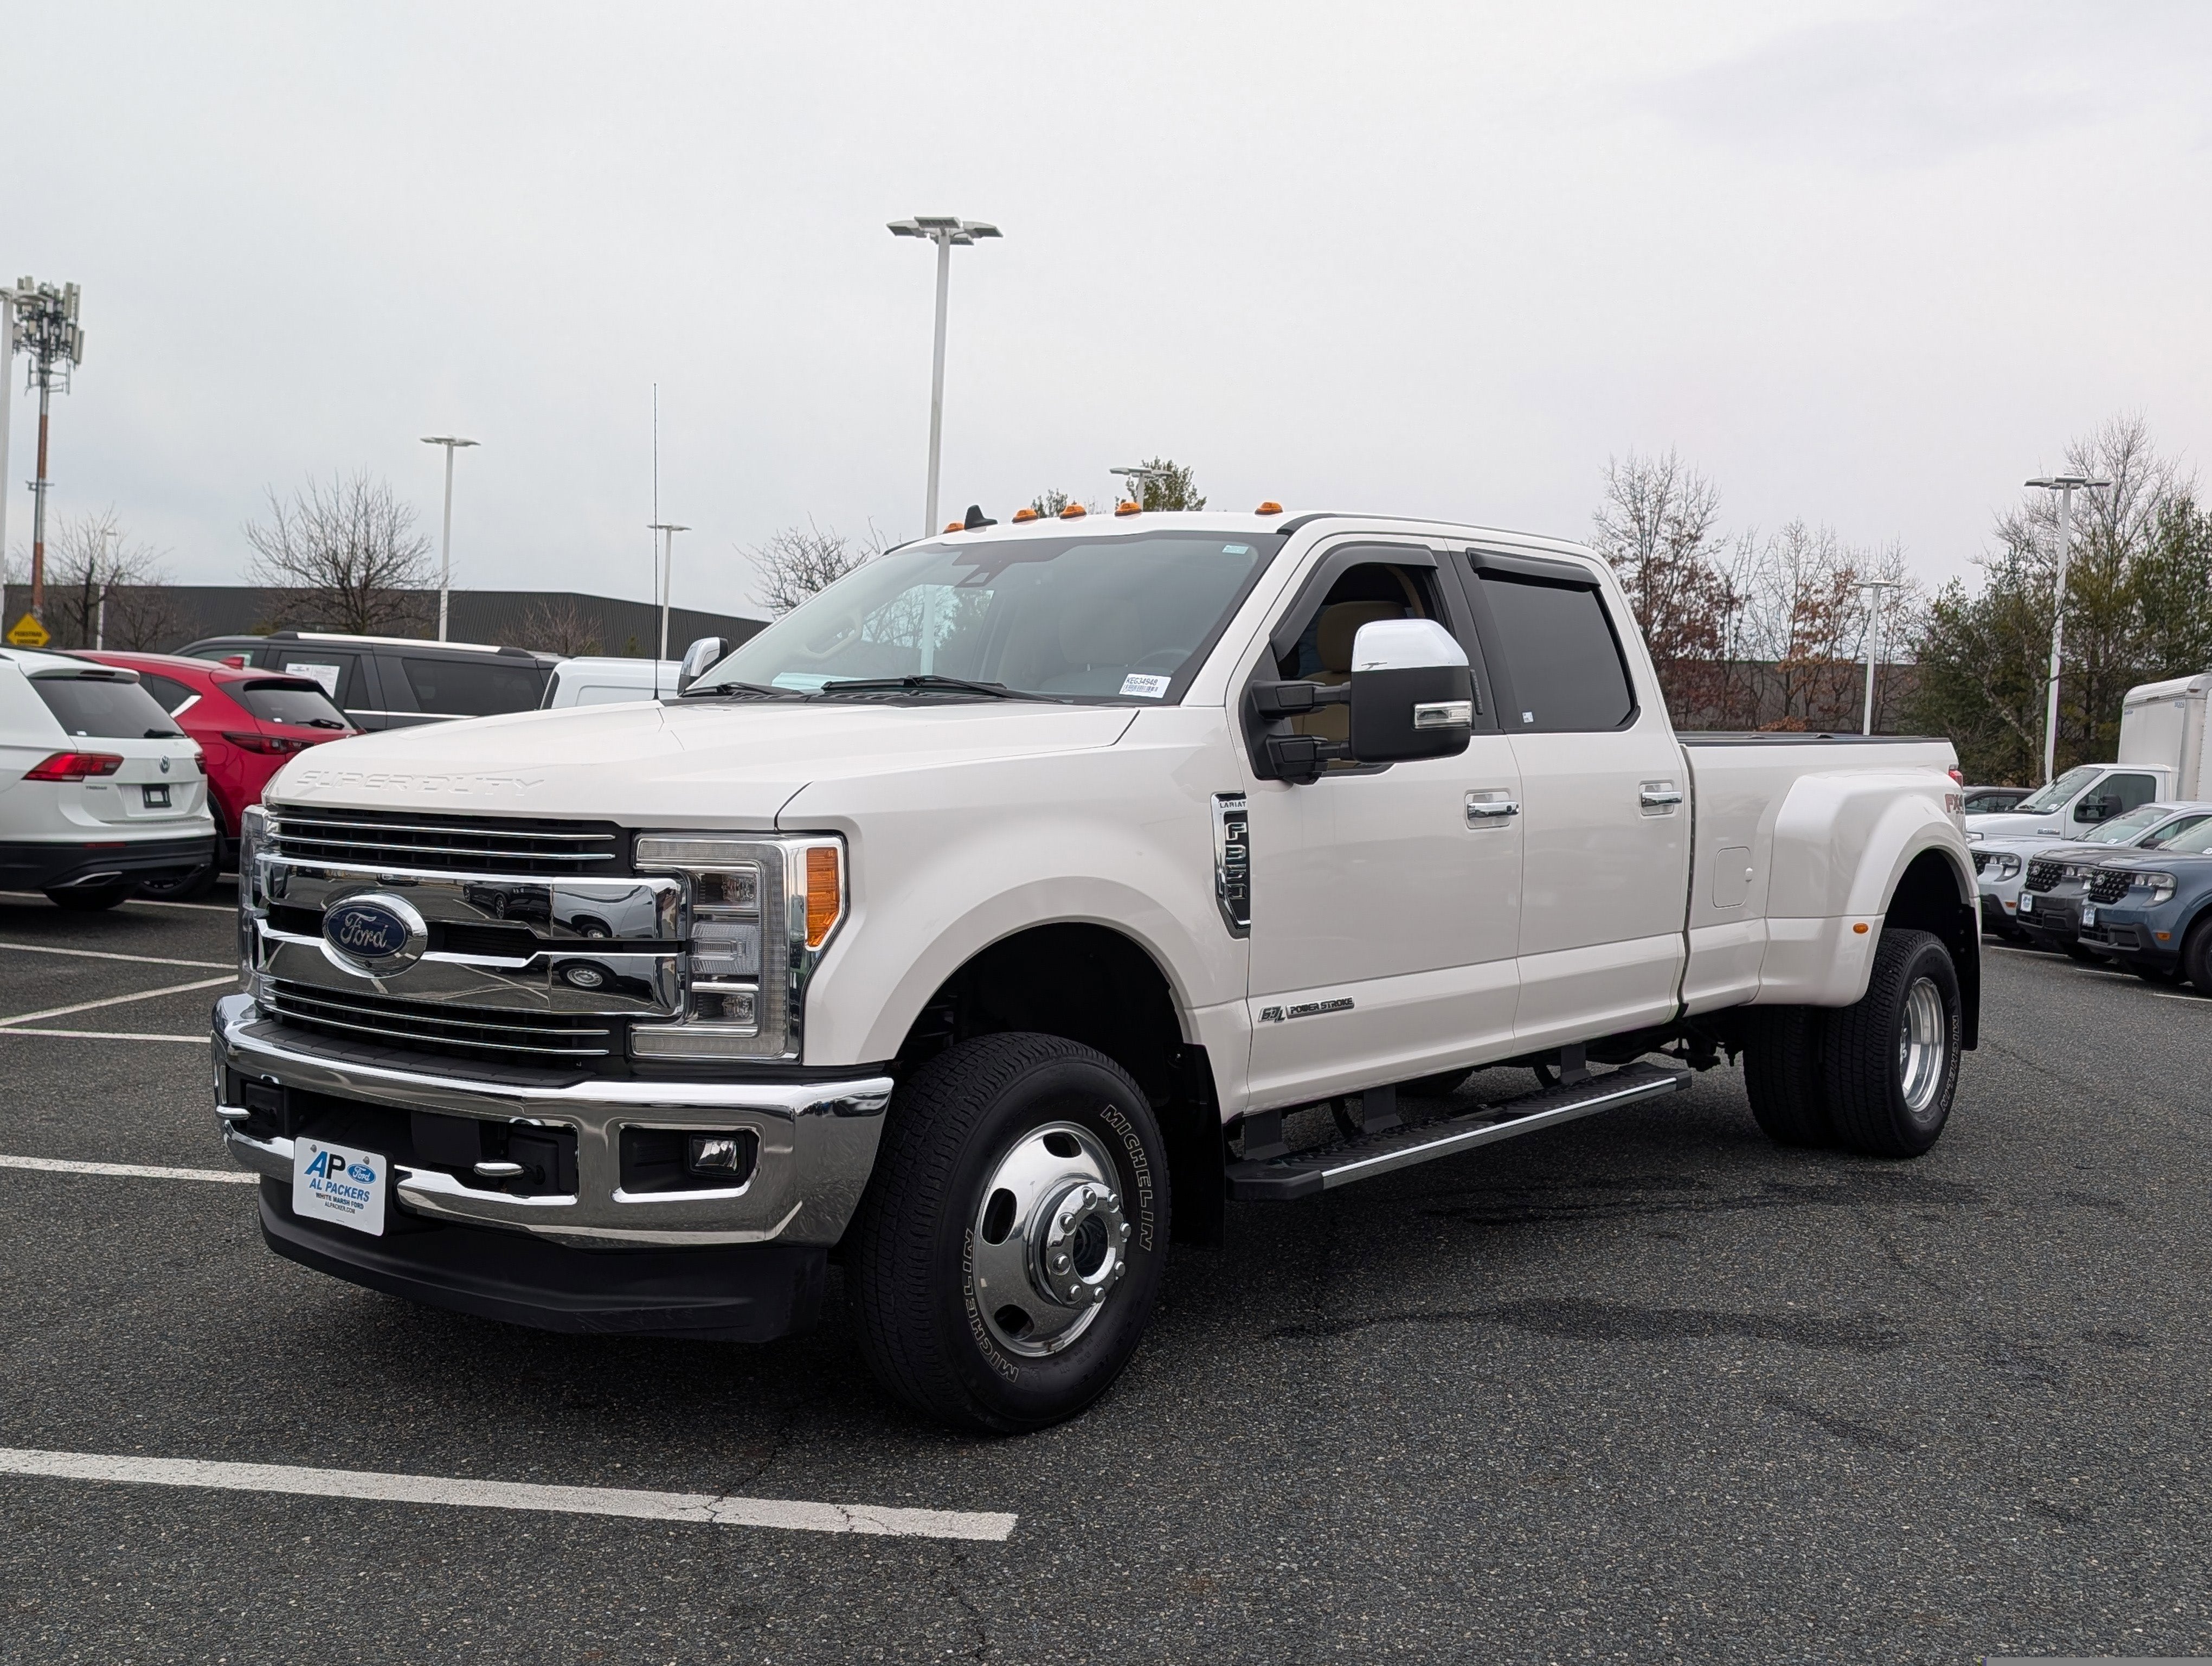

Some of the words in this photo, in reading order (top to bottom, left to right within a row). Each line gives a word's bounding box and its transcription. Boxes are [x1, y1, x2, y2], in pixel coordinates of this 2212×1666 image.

[295, 770, 414, 791] SUPER
[416, 775, 545, 796] DUTY
[340, 912, 389, 949] Ford
[1290, 1002, 1320, 1014] POWER
[1320, 997, 1353, 1009] STROKE
[304, 1150, 346, 1180] AP
[352, 1166, 371, 1182] Ford
[1099, 1104, 1154, 1251] MICHELIN
[309, 1178, 323, 1190] AL
[325, 1181, 371, 1202] PACKERS
[316, 1192, 332, 1201] WHITE
[332, 1196, 350, 1207] MARSH
[351, 1200, 364, 1210] FORD
[962, 1228, 1019, 1383] MICHELIN
